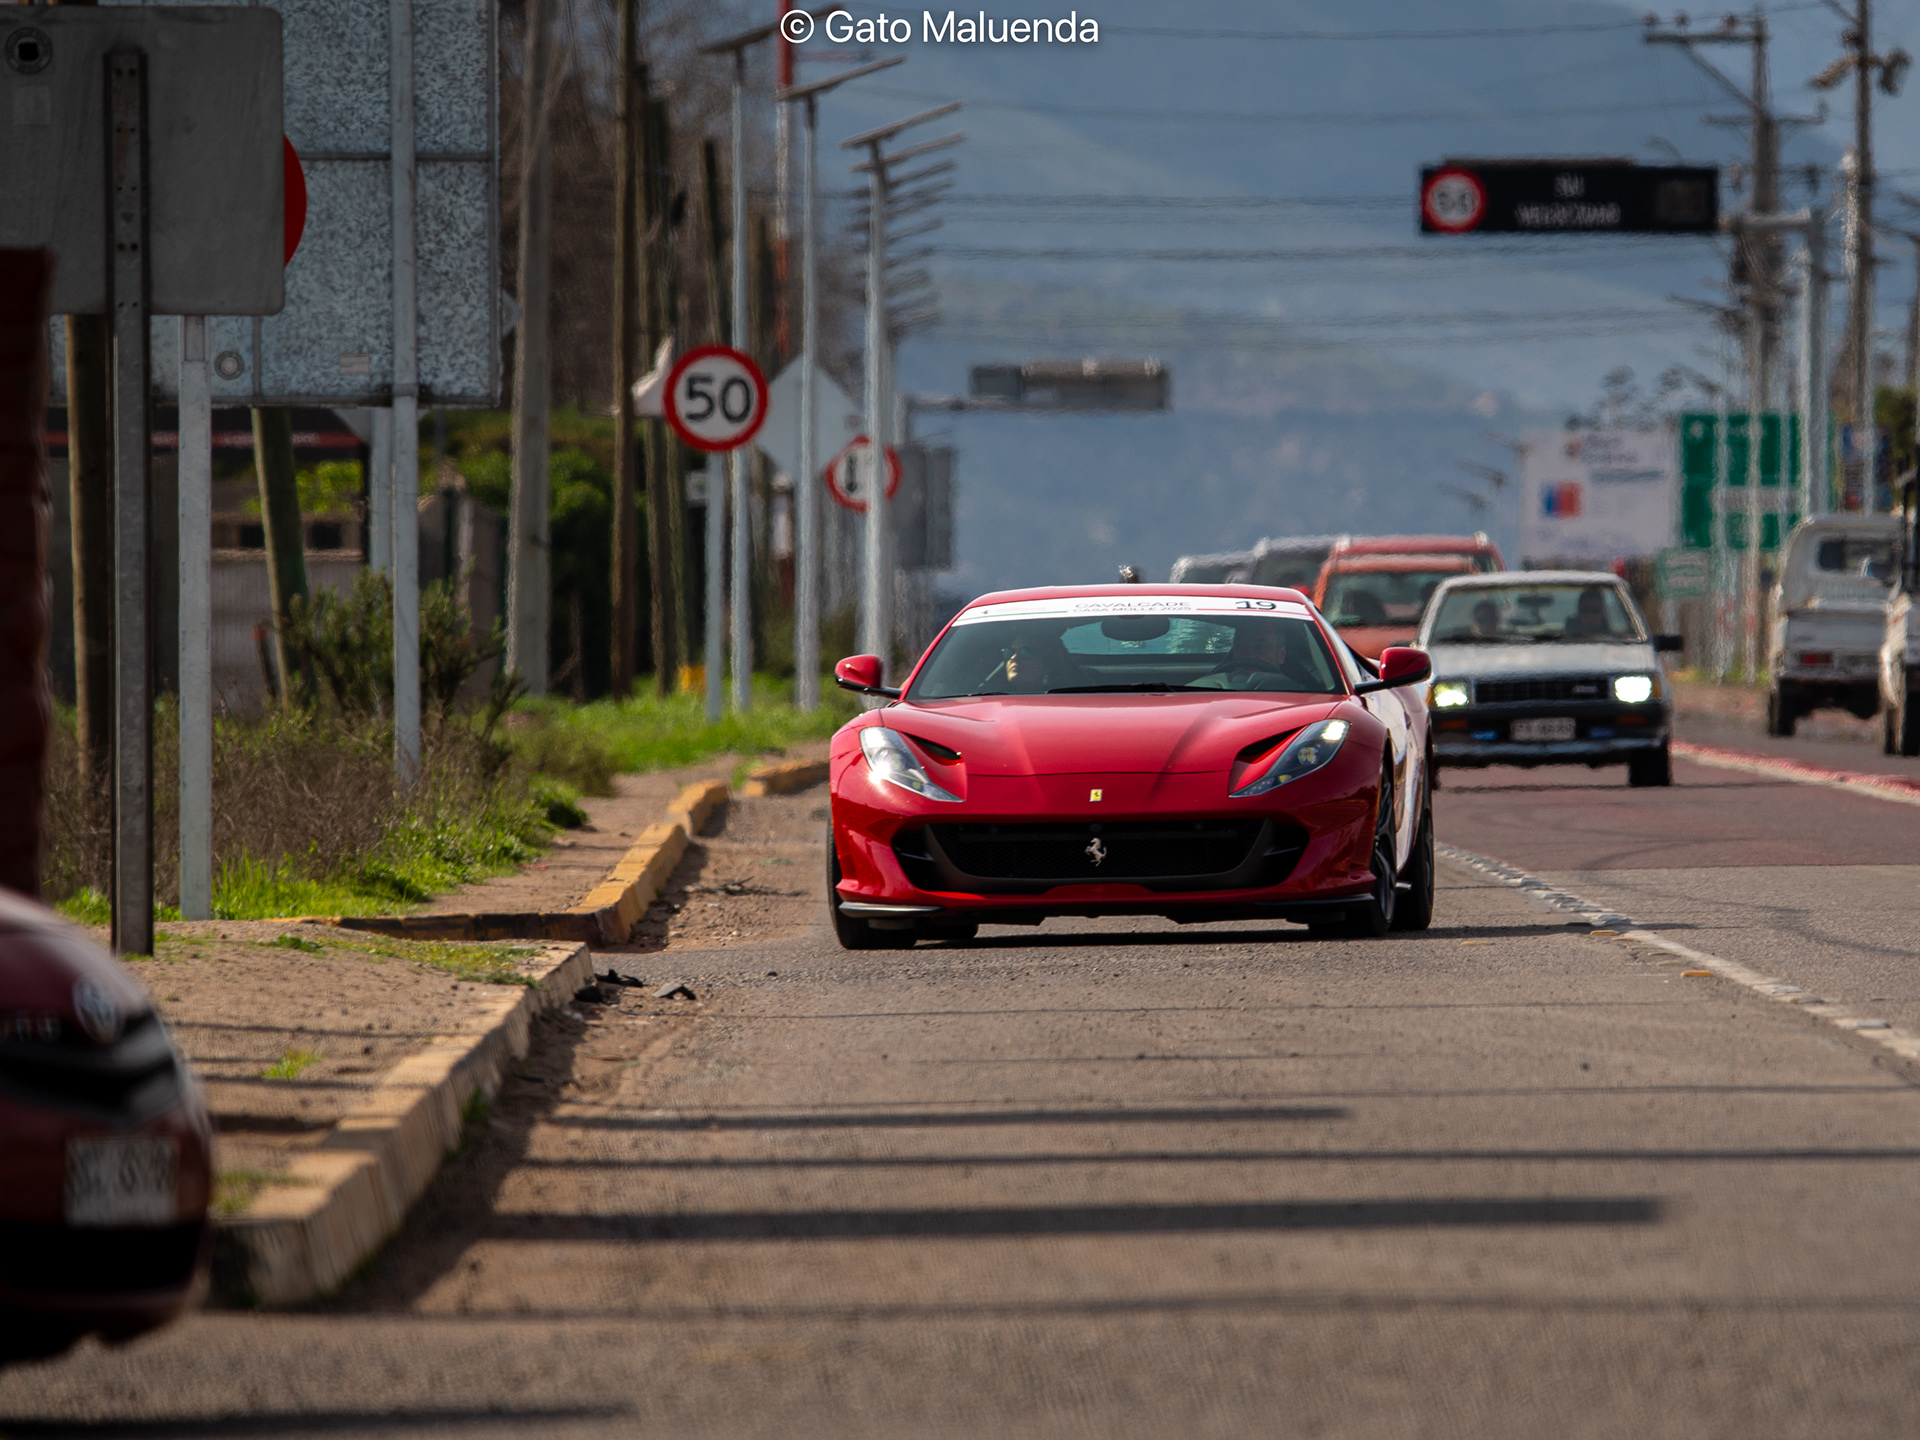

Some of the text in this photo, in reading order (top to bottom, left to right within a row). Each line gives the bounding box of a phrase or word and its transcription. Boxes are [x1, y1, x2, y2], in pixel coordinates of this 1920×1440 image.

[684, 372, 752, 424] 50
[1074, 601, 1190, 609] CAVALCADE
[1235, 600, 1277, 610] 19
